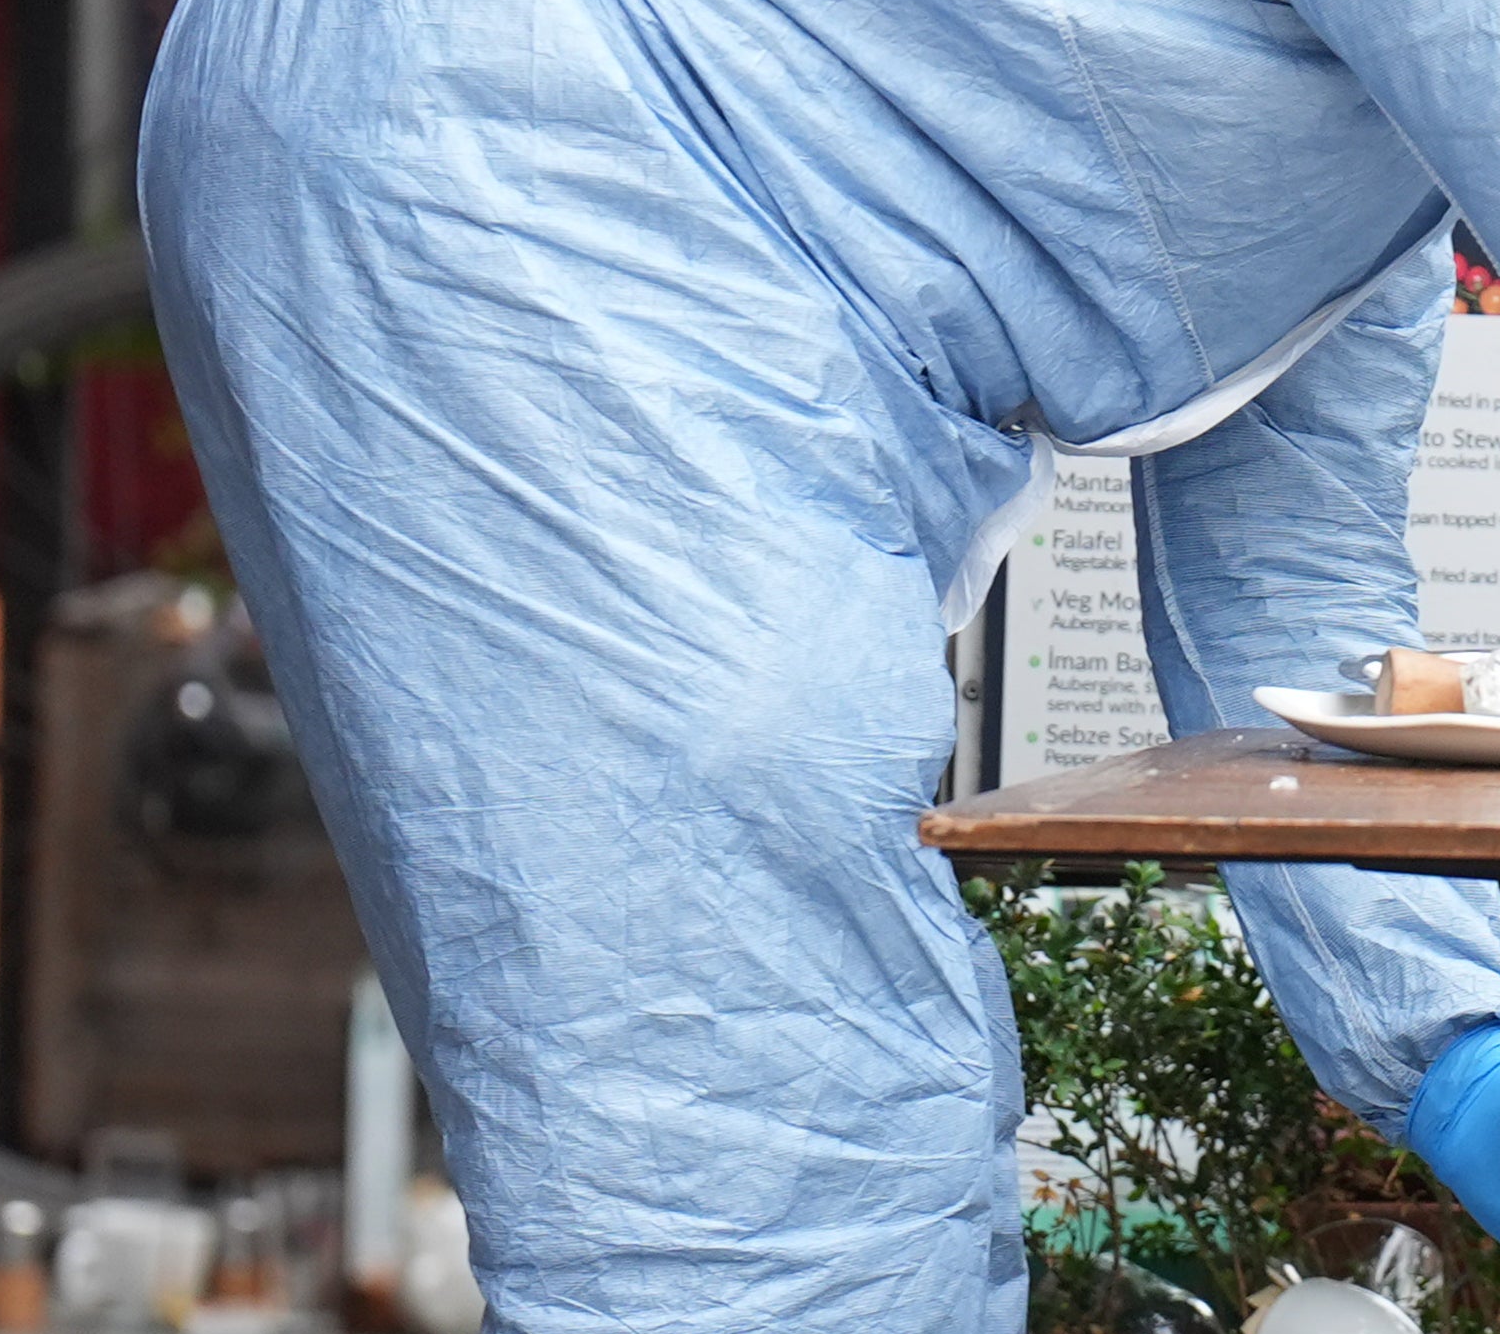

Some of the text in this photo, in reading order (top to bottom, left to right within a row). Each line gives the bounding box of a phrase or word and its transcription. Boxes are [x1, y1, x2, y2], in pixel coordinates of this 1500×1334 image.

[1437, 391, 1473, 409] fried
[1476, 393, 1491, 409] in
[1427, 455, 1490, 471] cooked
[1408, 514, 1439, 530] pan
[1441, 512, 1497, 532] topped
[1051, 528, 1124, 551] Falafel
[1050, 553, 1128, 573] Vegetable
[1430, 568, 1466, 584] fried
[1468, 569, 1499, 585] and
[1050, 588, 1094, 614] Veg
[1449, 630, 1479, 646] and
[1046, 697, 1105, 714] served
[1108, 698, 1147, 715] with
[1045, 722, 1112, 746] Sebze
